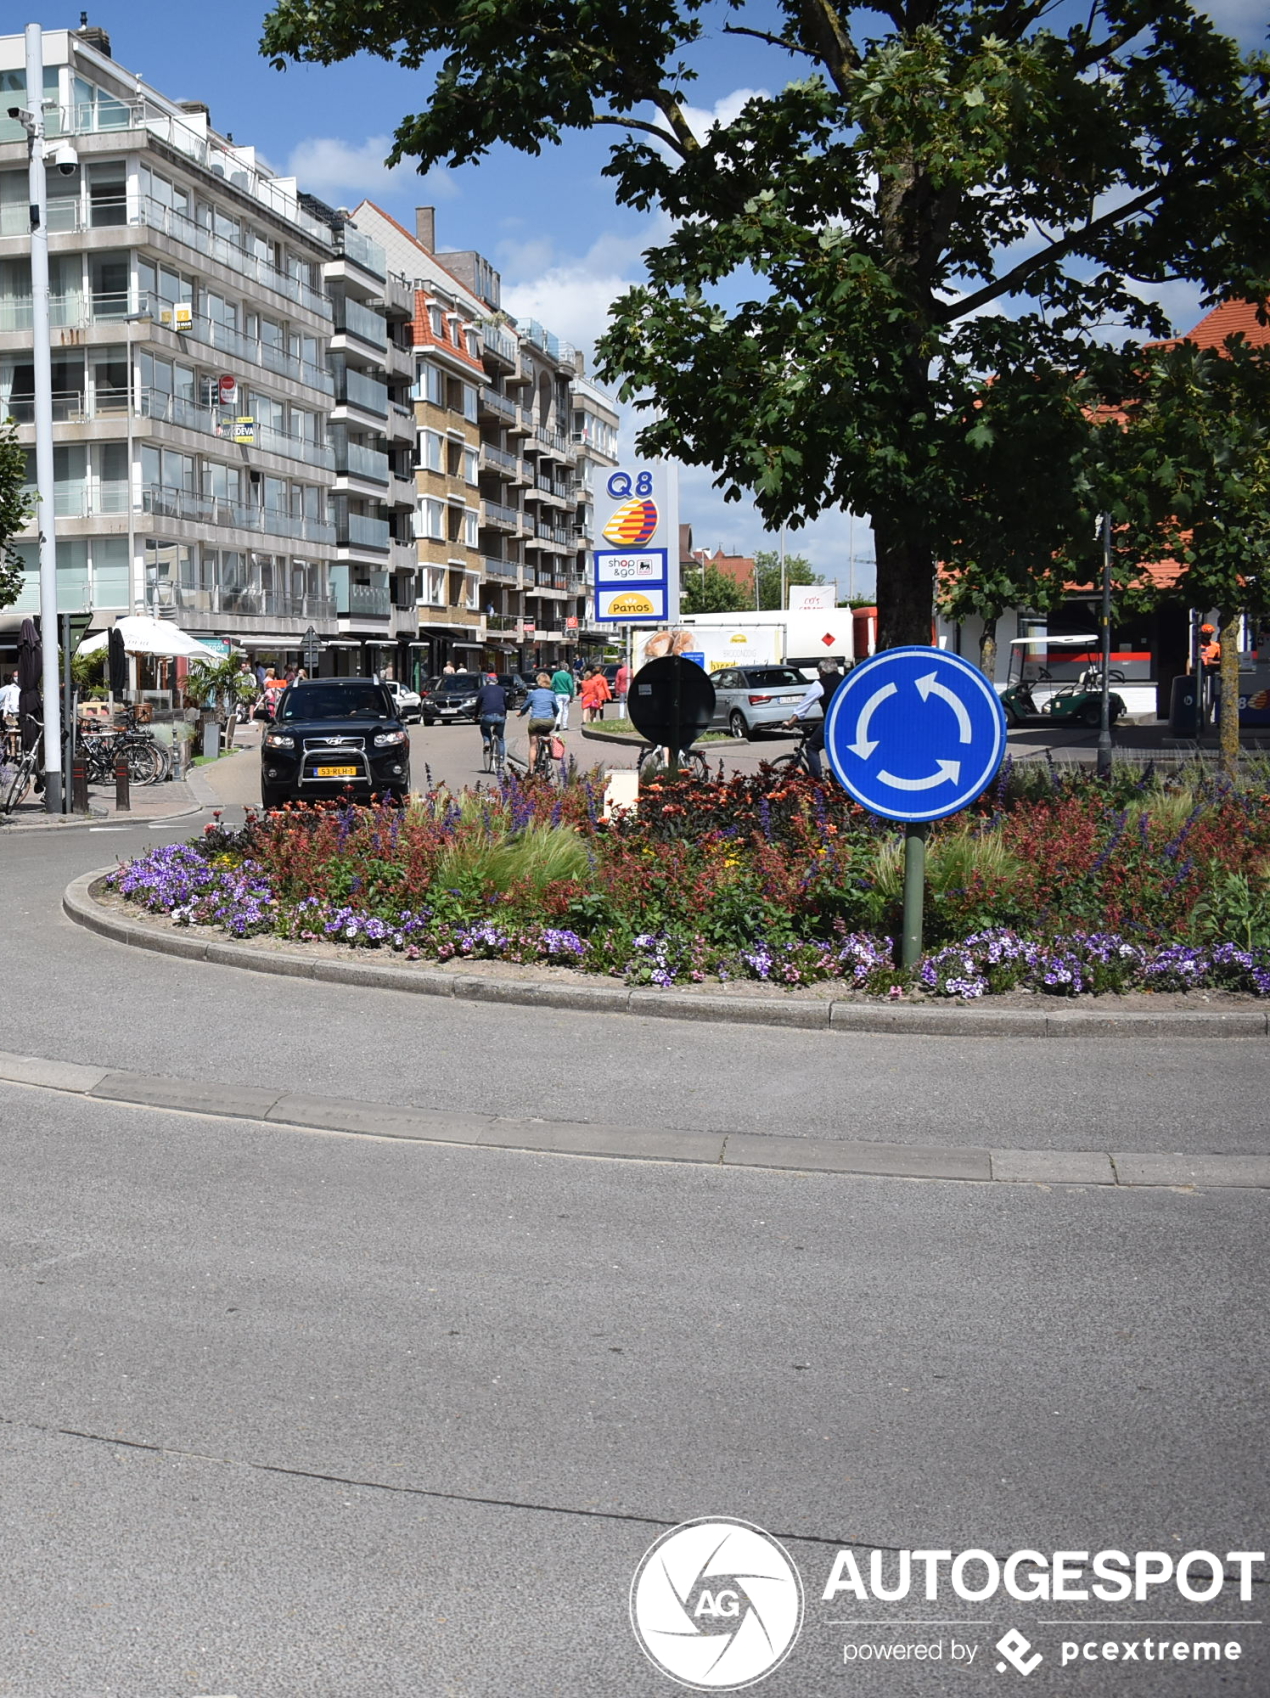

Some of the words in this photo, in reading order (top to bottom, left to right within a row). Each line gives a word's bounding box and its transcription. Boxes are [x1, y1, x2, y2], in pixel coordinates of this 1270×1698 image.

[607, 471, 653, 498] Q8
[608, 558, 635, 568] shop
[614, 568, 635, 578] &go
[613, 603, 650, 613] Panos
